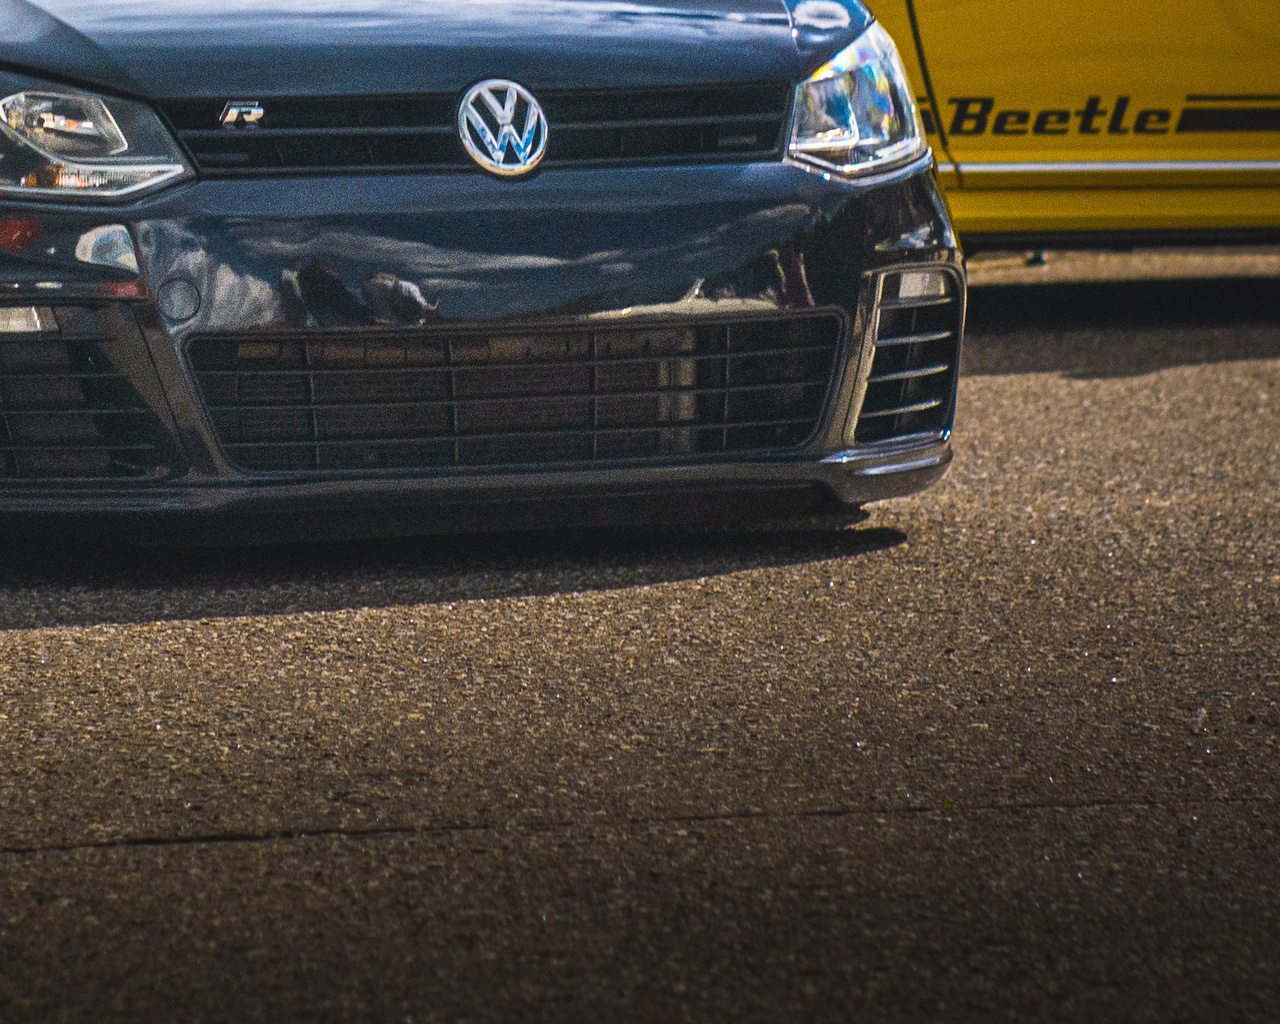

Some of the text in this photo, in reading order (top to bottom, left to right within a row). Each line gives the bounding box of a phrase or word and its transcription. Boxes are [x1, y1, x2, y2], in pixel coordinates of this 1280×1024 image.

[219, 100, 264, 124] R
[462, 83, 544, 170] VW
[947, 95, 1171, 136] Beetle
